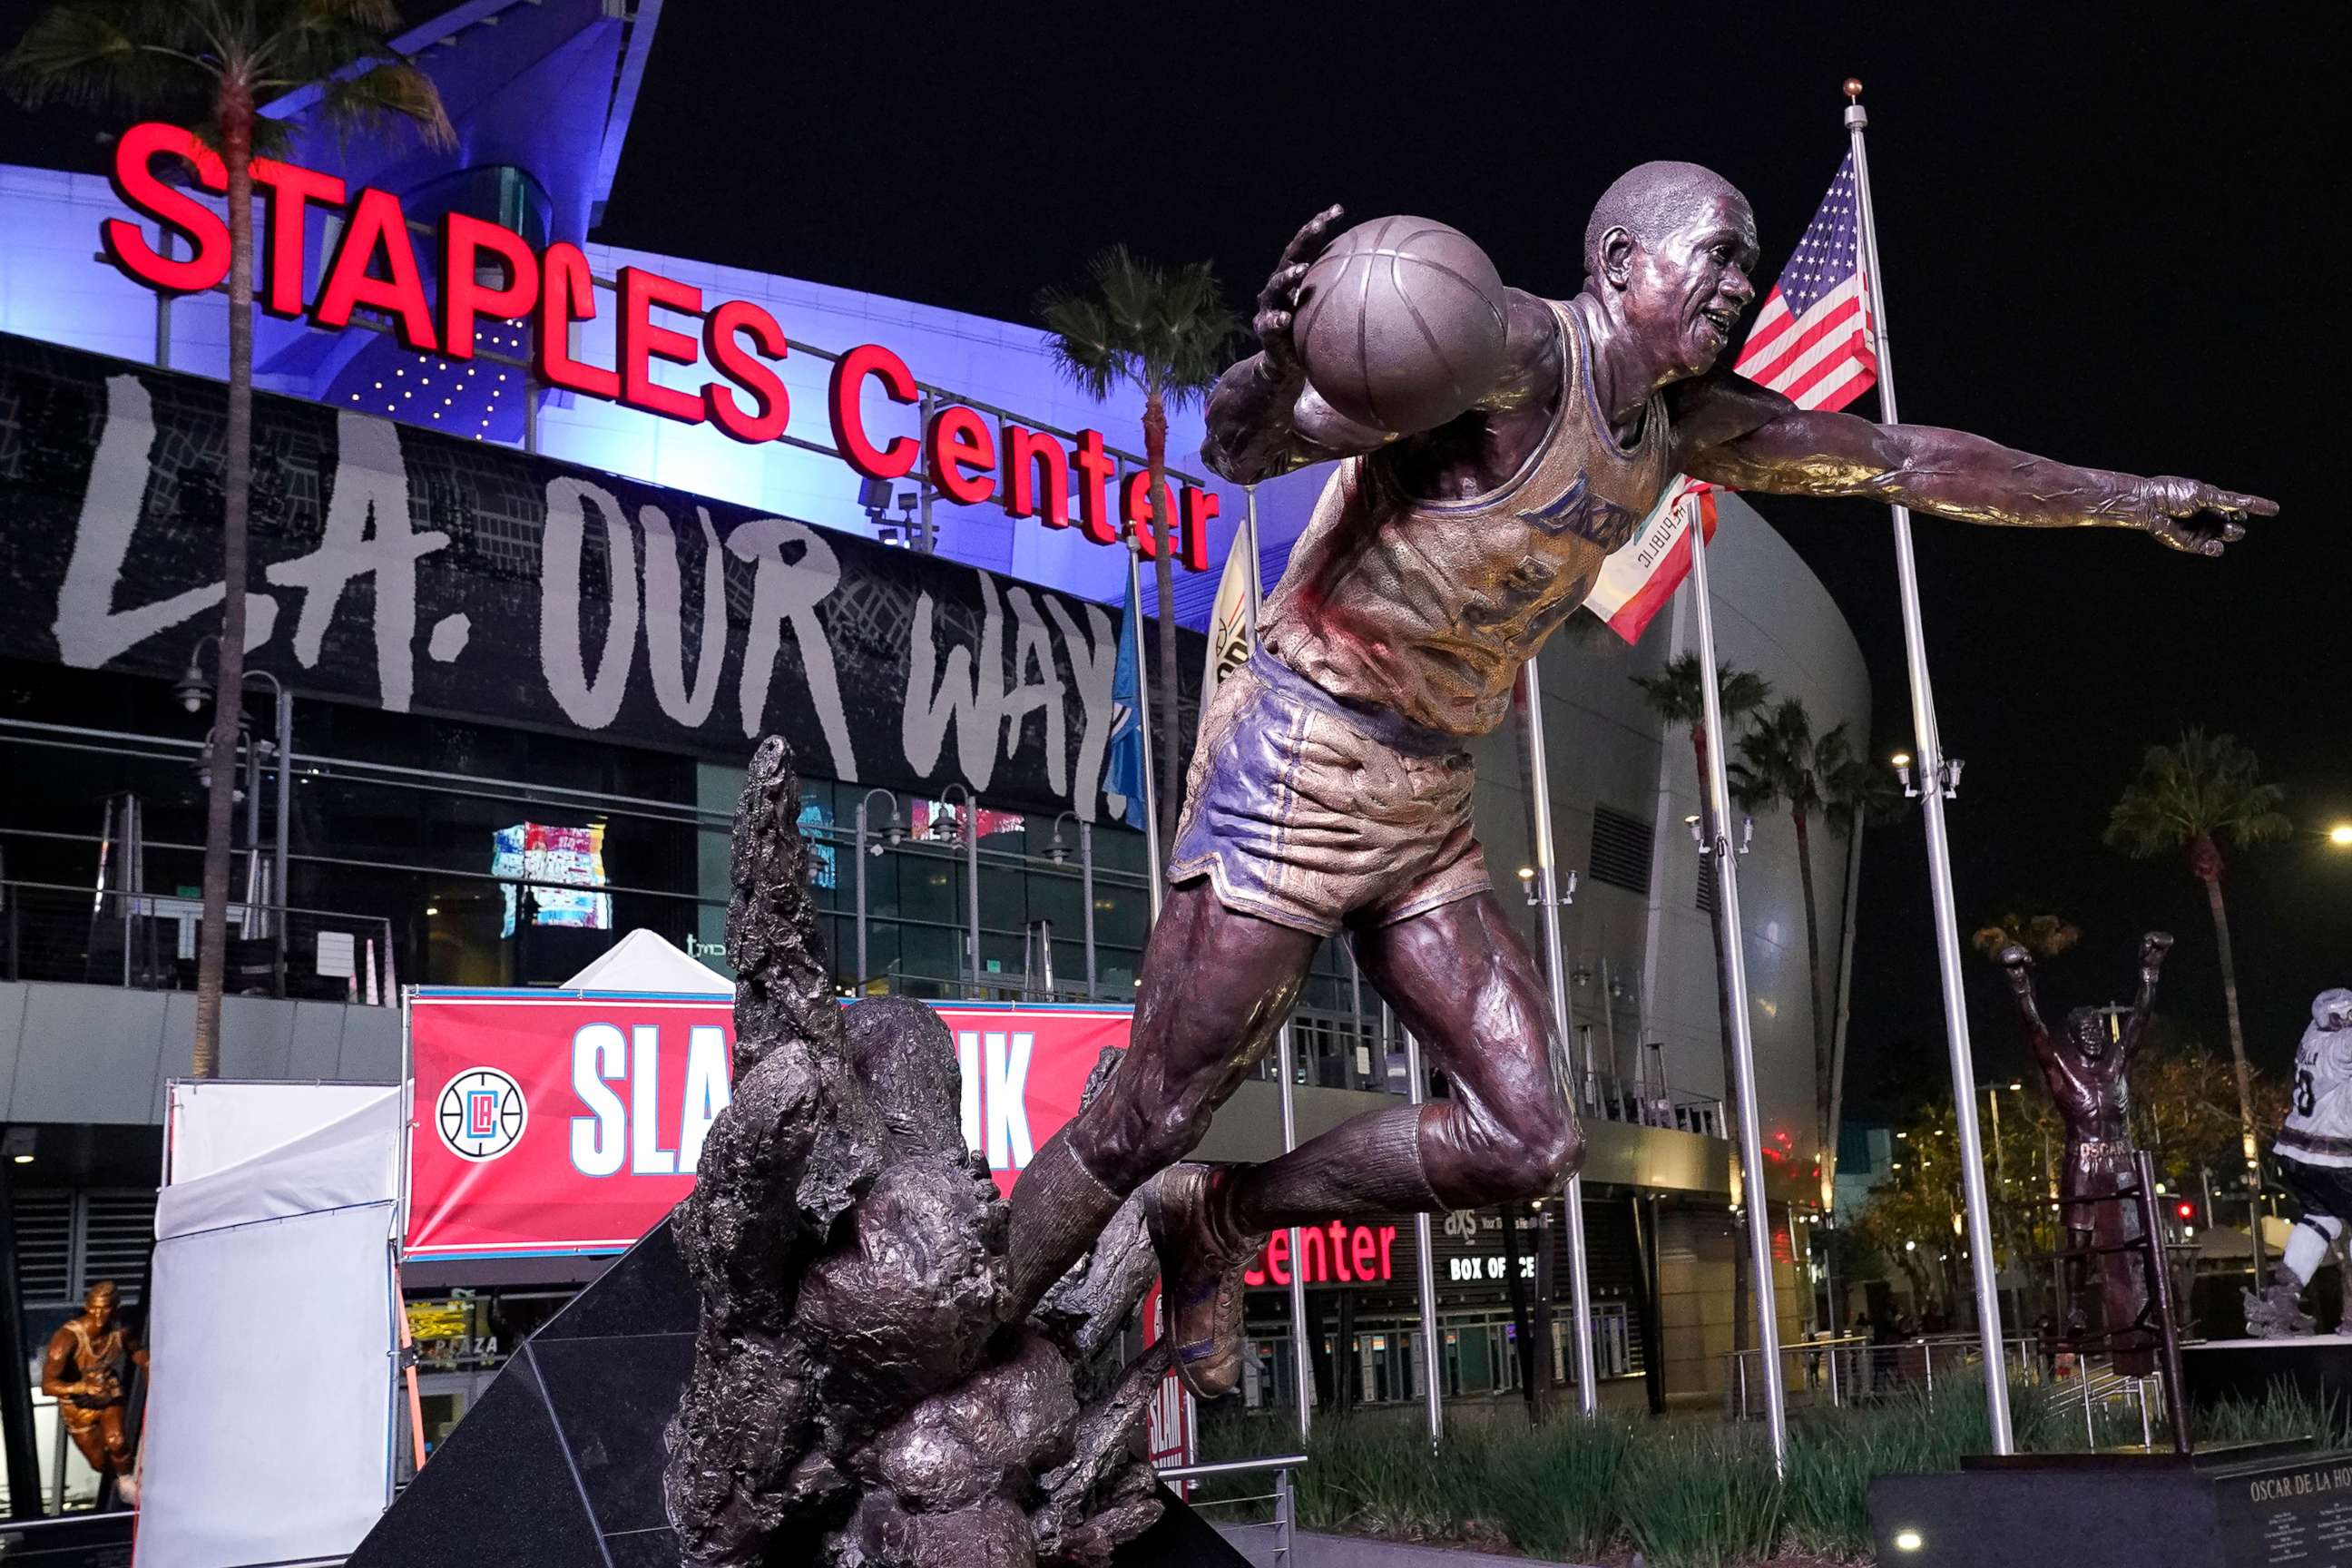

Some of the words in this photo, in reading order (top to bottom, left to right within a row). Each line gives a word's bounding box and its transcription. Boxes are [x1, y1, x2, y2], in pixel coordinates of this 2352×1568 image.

[102, 121, 789, 444] STAPLES
[829, 343, 1220, 573] Center
[540, 475, 858, 782] OUR
[2080, 1142, 2126, 1158] OSCAR
[1450, 1257, 1483, 1280] BOX
[1487, 1256, 1535, 1279] OFCE
[2250, 1477, 2292, 1503] OSCAR
[2294, 1473, 2314, 1495] DE
[2315, 1471, 2332, 1492] LA
[2333, 1466, 2352, 1489] HO
